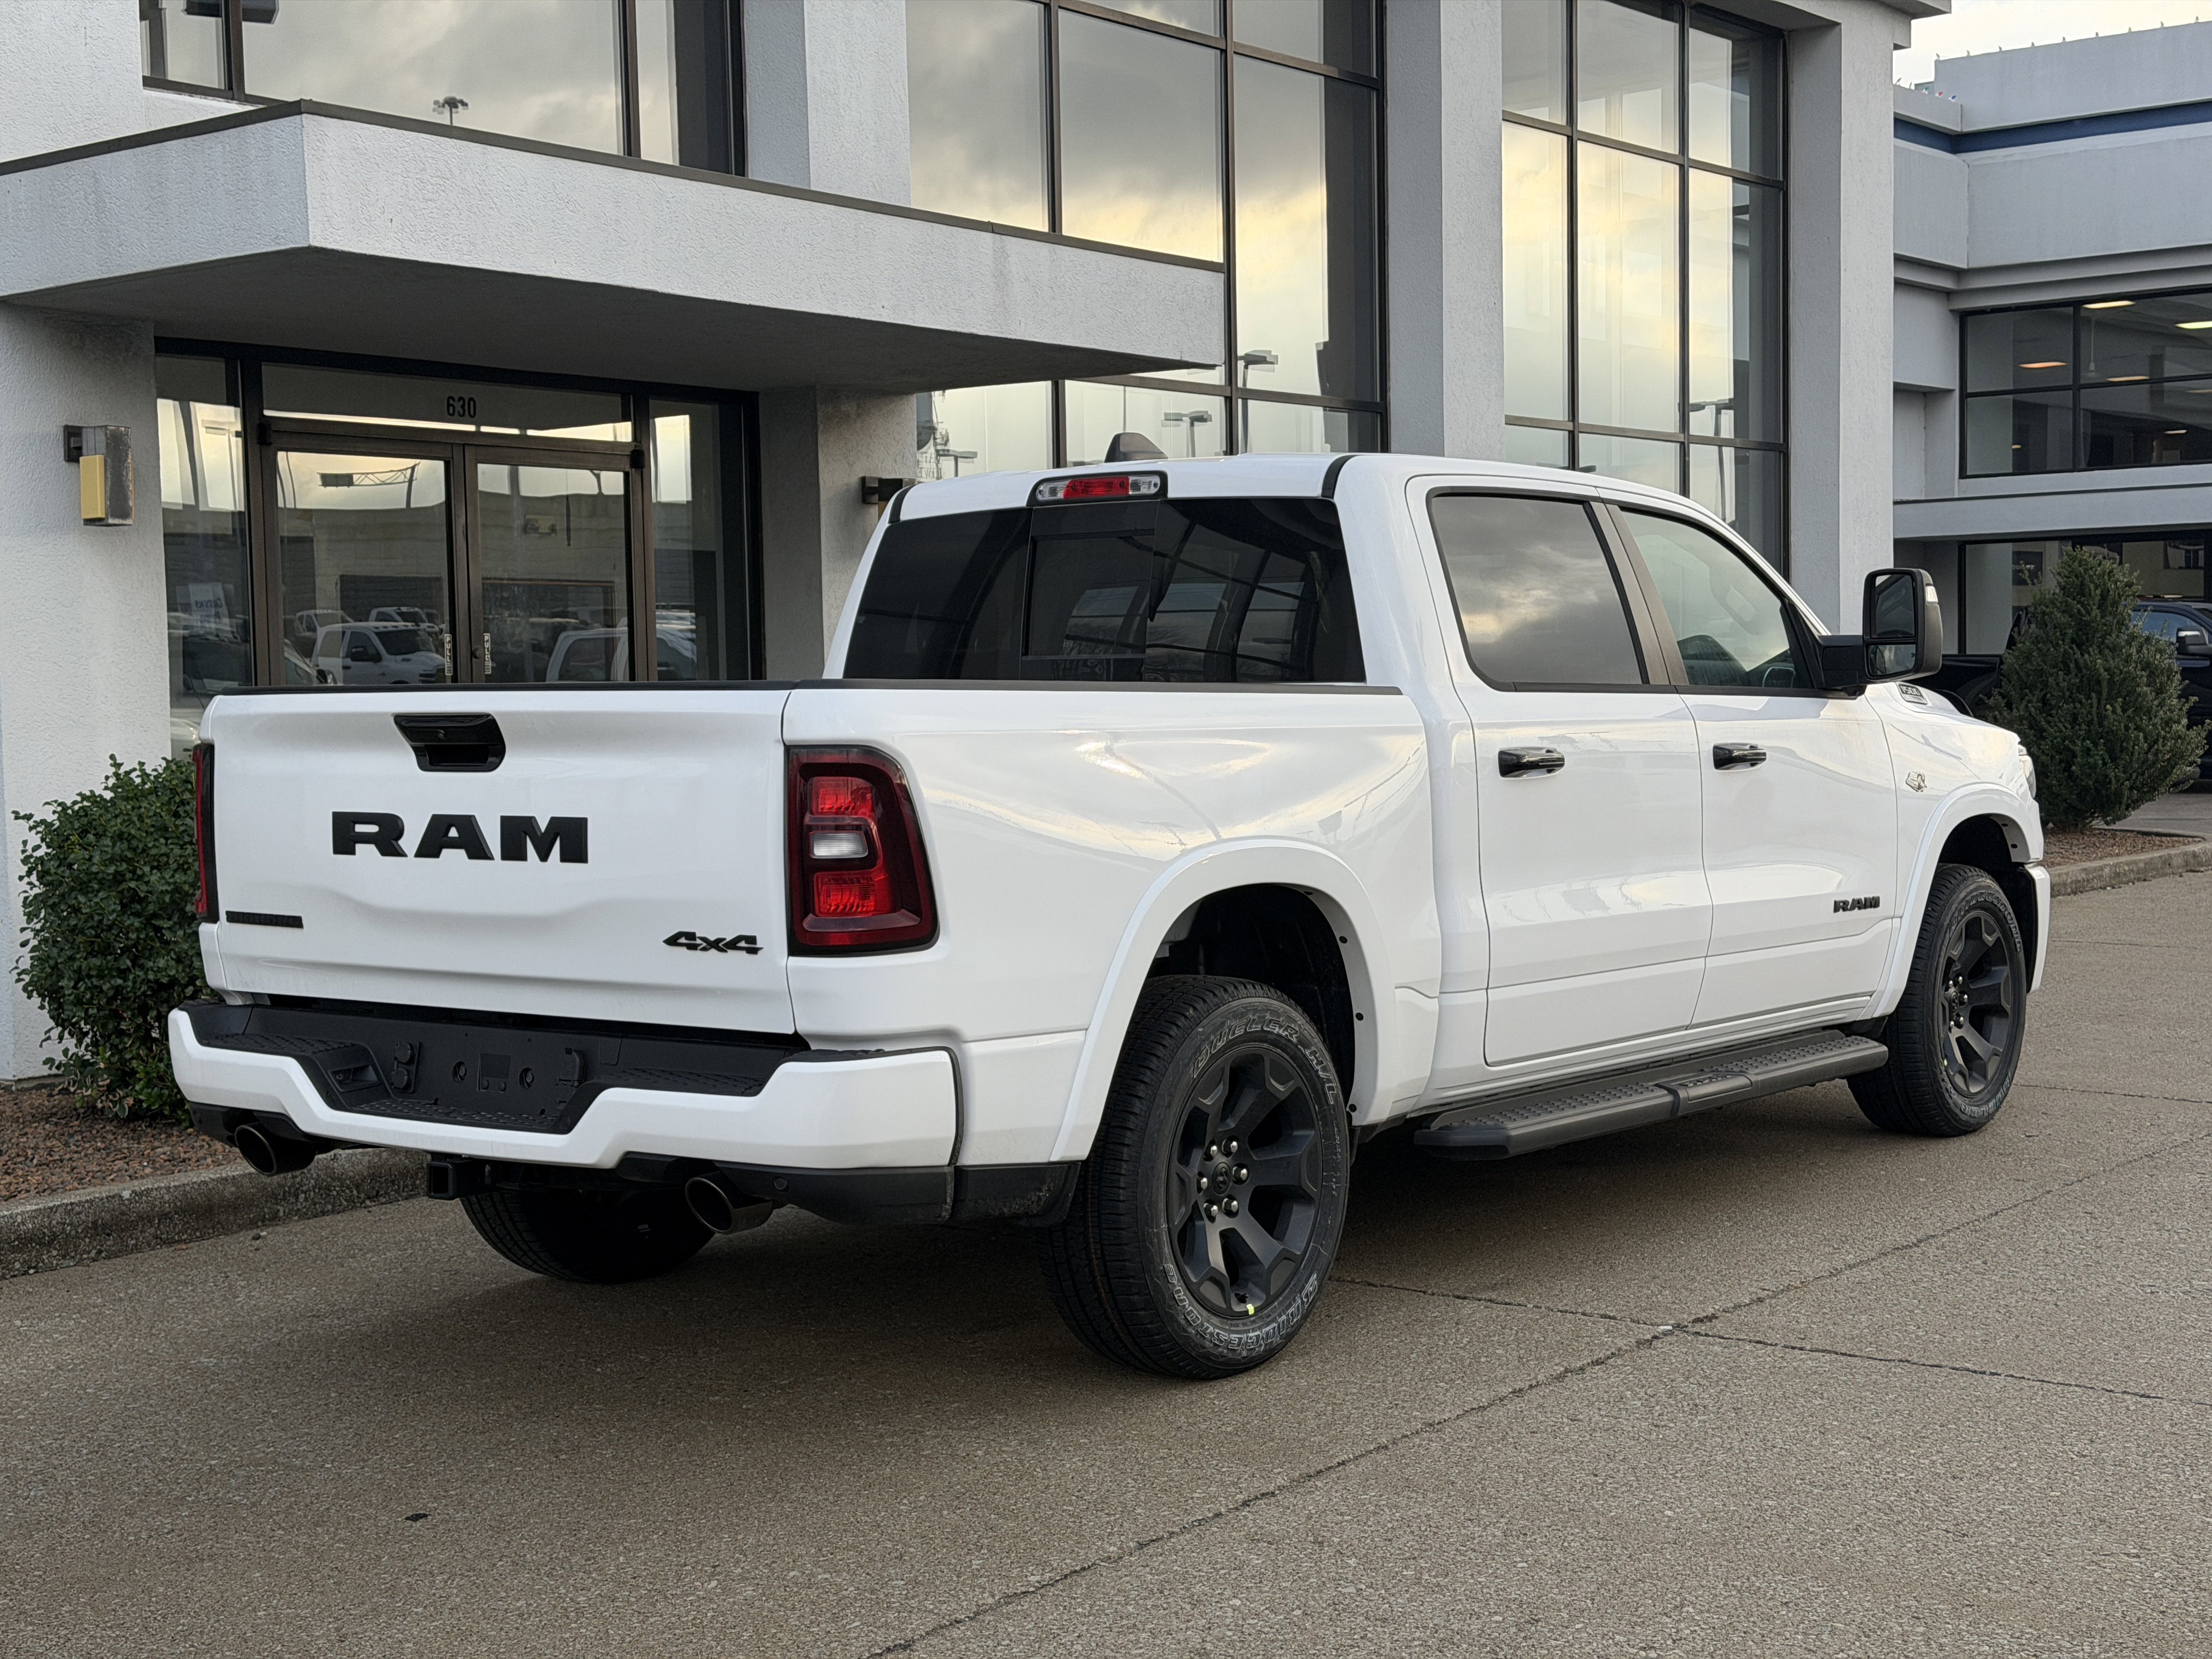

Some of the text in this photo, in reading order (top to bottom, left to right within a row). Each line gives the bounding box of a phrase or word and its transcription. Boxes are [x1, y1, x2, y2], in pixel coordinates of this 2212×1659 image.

[447, 396, 476, 418] 630
[1900, 685, 1921, 696] 1500
[332, 811, 588, 864] RAM
[1833, 896, 1880, 913] RAM
[1193, 1017, 1300, 1079] DUELER
[1164, 1263, 1317, 1350] BRIDGESTONE
